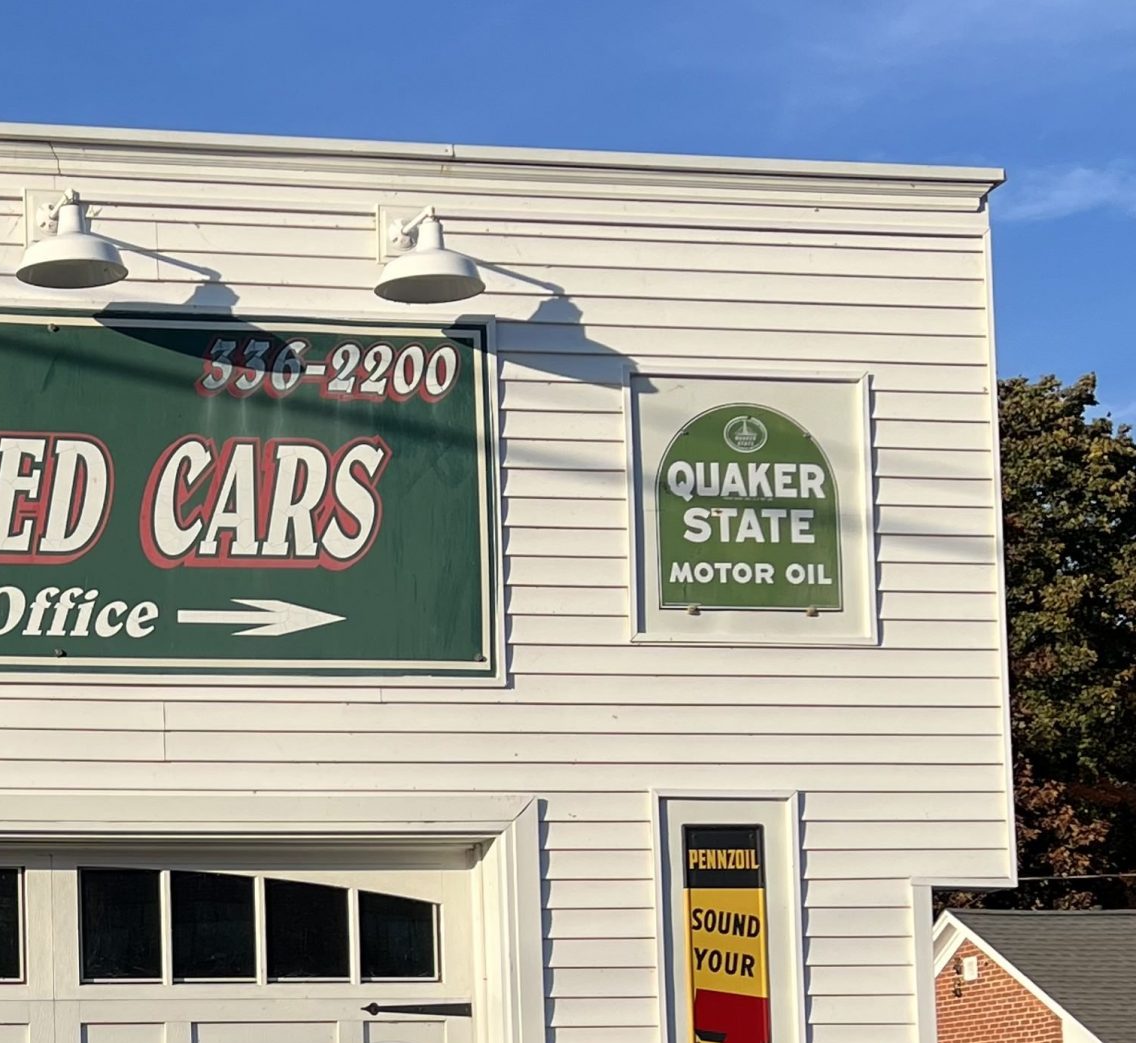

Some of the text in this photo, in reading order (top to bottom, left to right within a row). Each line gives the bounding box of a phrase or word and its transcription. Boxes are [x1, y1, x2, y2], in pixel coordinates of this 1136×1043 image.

[199, 337, 459, 400] 336-2200
[667, 460, 826, 502] QUAKER
[146, 437, 388, 566] CARS
[683, 507, 815, 543] STATE
[669, 562, 833, 585] MOTOR OIL
[688, 849, 760, 870] PENNZOIL
[692, 908, 760, 938] SOUND
[694, 947, 755, 977] YOUR
